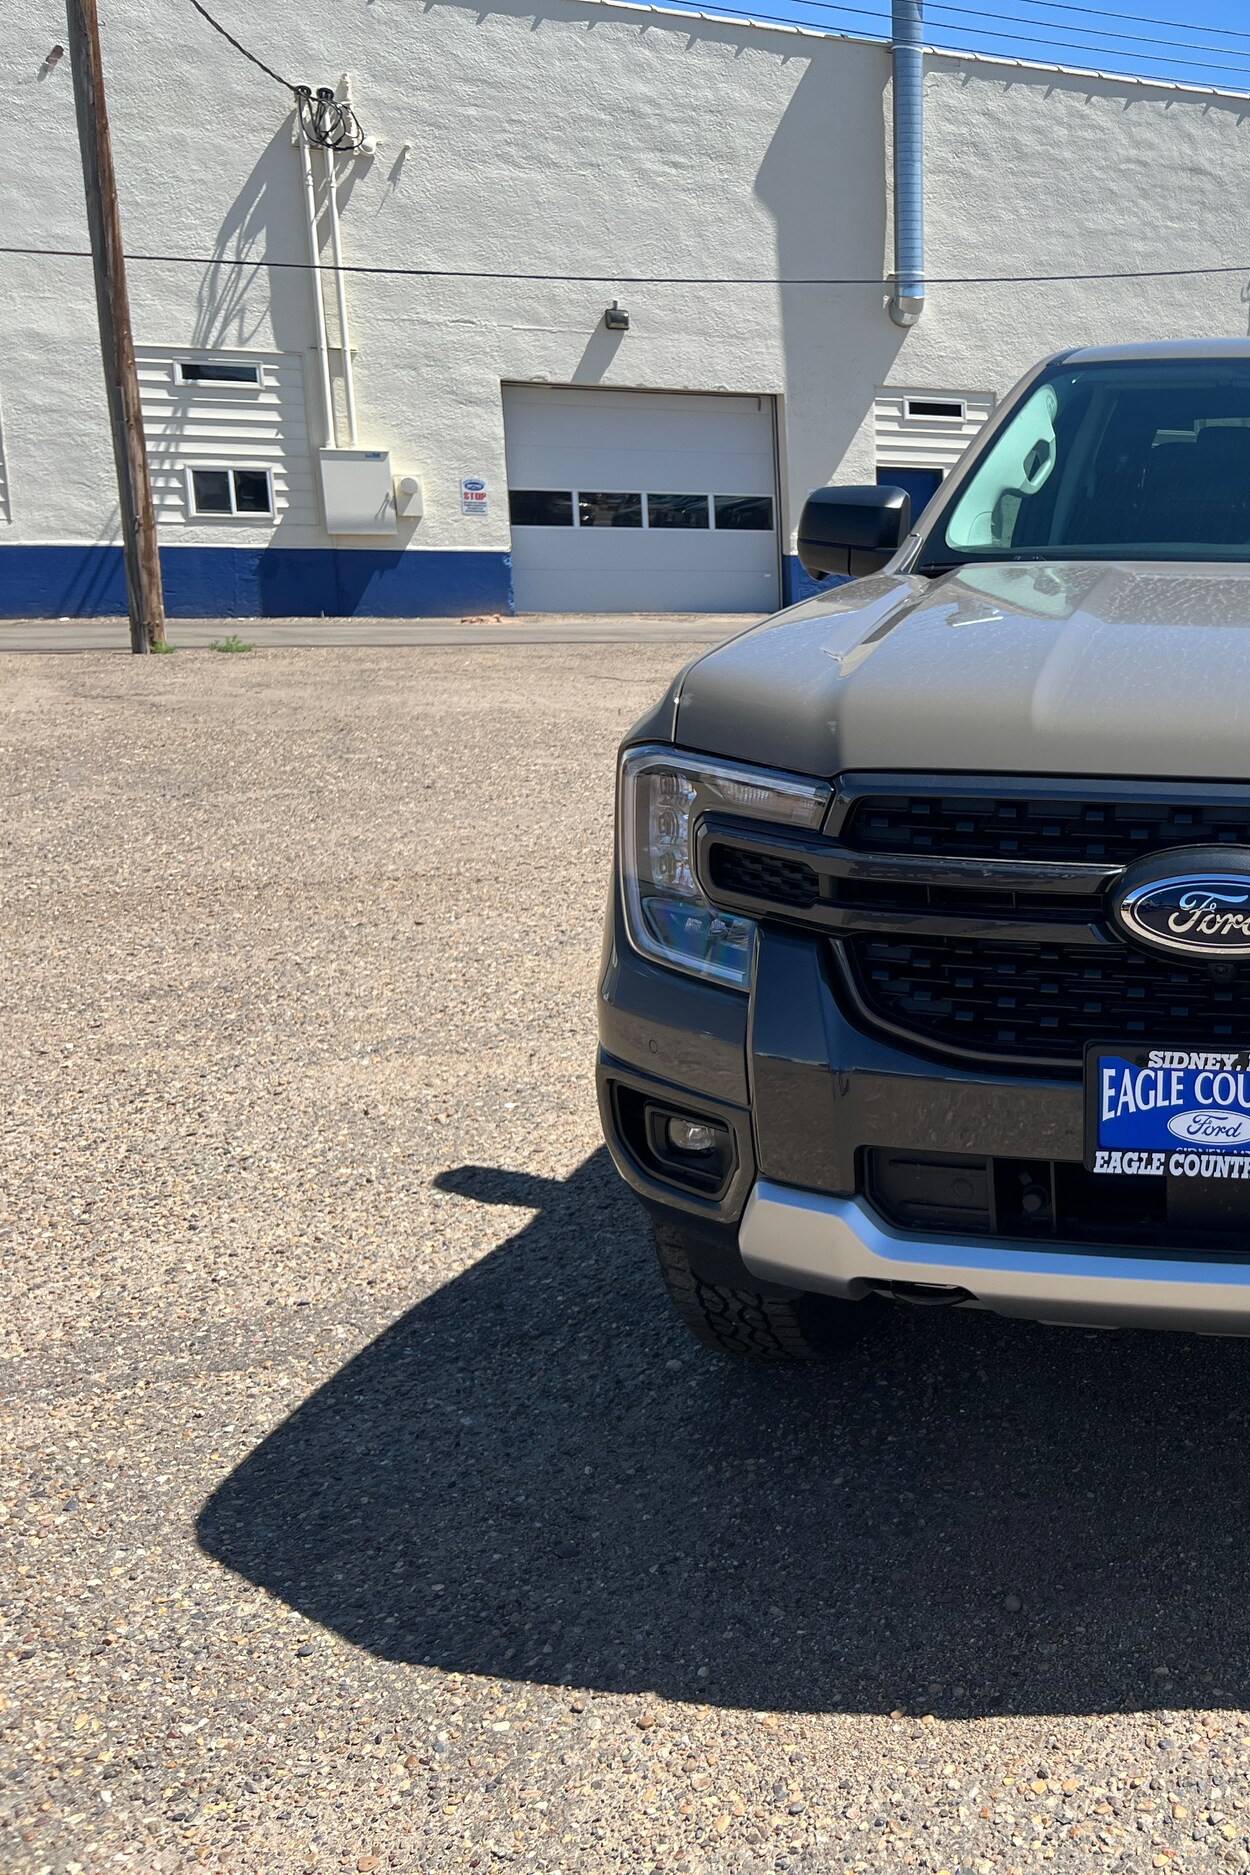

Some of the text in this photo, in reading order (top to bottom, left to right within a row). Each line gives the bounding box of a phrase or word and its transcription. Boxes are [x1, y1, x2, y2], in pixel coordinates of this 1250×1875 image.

[463, 492, 486, 500] STOP
[1101, 1068, 1184, 1122] EAGLE
[1186, 1113, 1243, 1139] Ford
[1093, 1150, 1166, 1176] EAGLE
